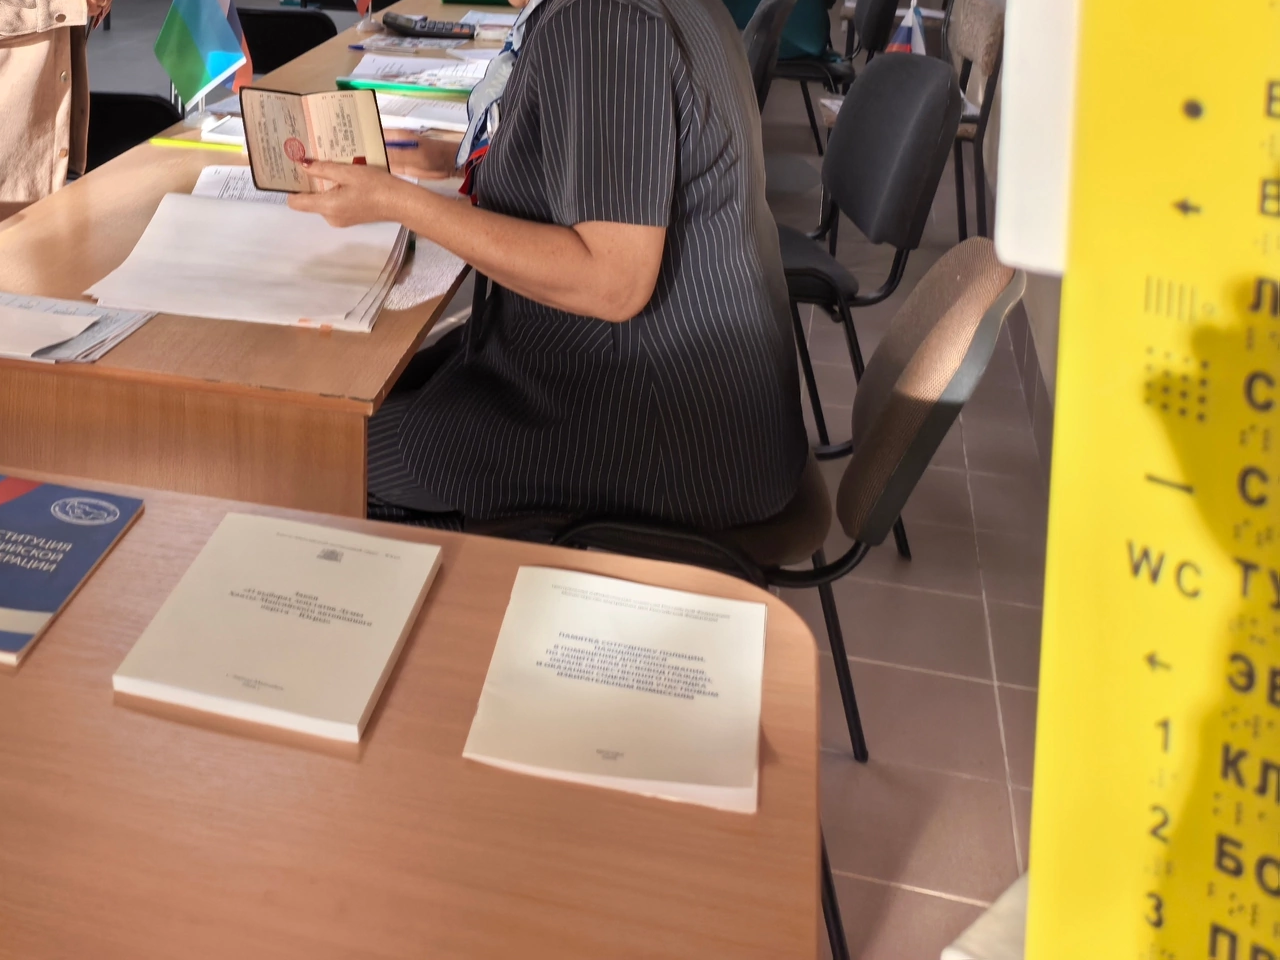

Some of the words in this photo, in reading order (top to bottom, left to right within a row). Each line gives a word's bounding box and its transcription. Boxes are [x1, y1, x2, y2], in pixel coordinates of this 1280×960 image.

[1128, 540, 1201, 598] WC
[1155, 717, 1170, 752] 1
[1150, 805, 1169, 844] 2
[1145, 892, 1164, 929] 3
